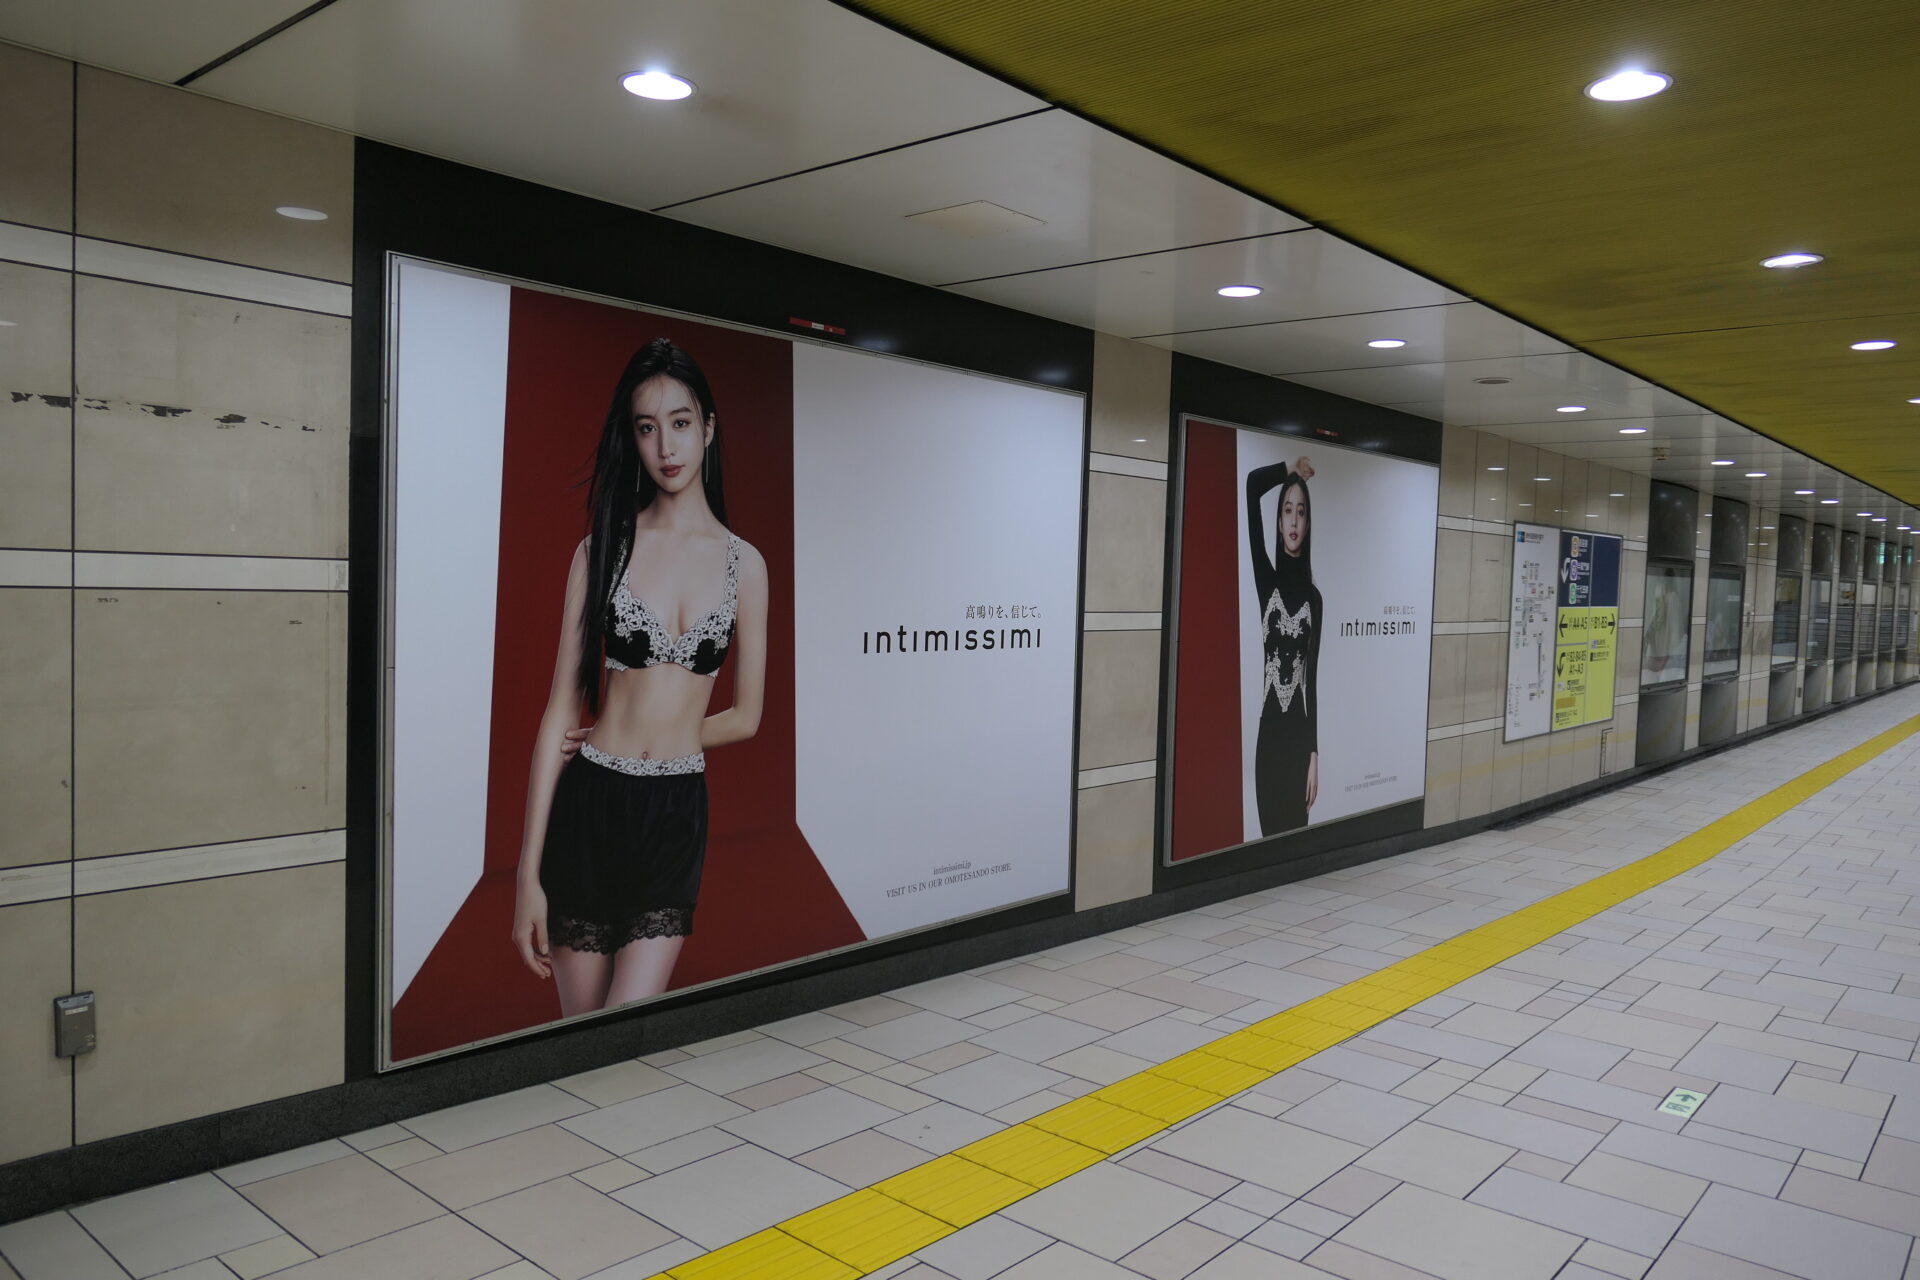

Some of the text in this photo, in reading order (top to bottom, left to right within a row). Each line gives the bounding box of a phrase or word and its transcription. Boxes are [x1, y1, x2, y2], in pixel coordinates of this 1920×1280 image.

[966, 604, 1042, 619] 高鳴りを、信じて。
[863, 625, 1041, 654] intimissimi
[1341, 618, 1416, 637] intimissimi
[886, 886, 906, 898] VISIT
[908, 883, 918, 894] US
[919, 882, 927, 891] IN
[928, 878, 943, 889] OUR
[944, 867, 990, 884] OMOTESANDO
